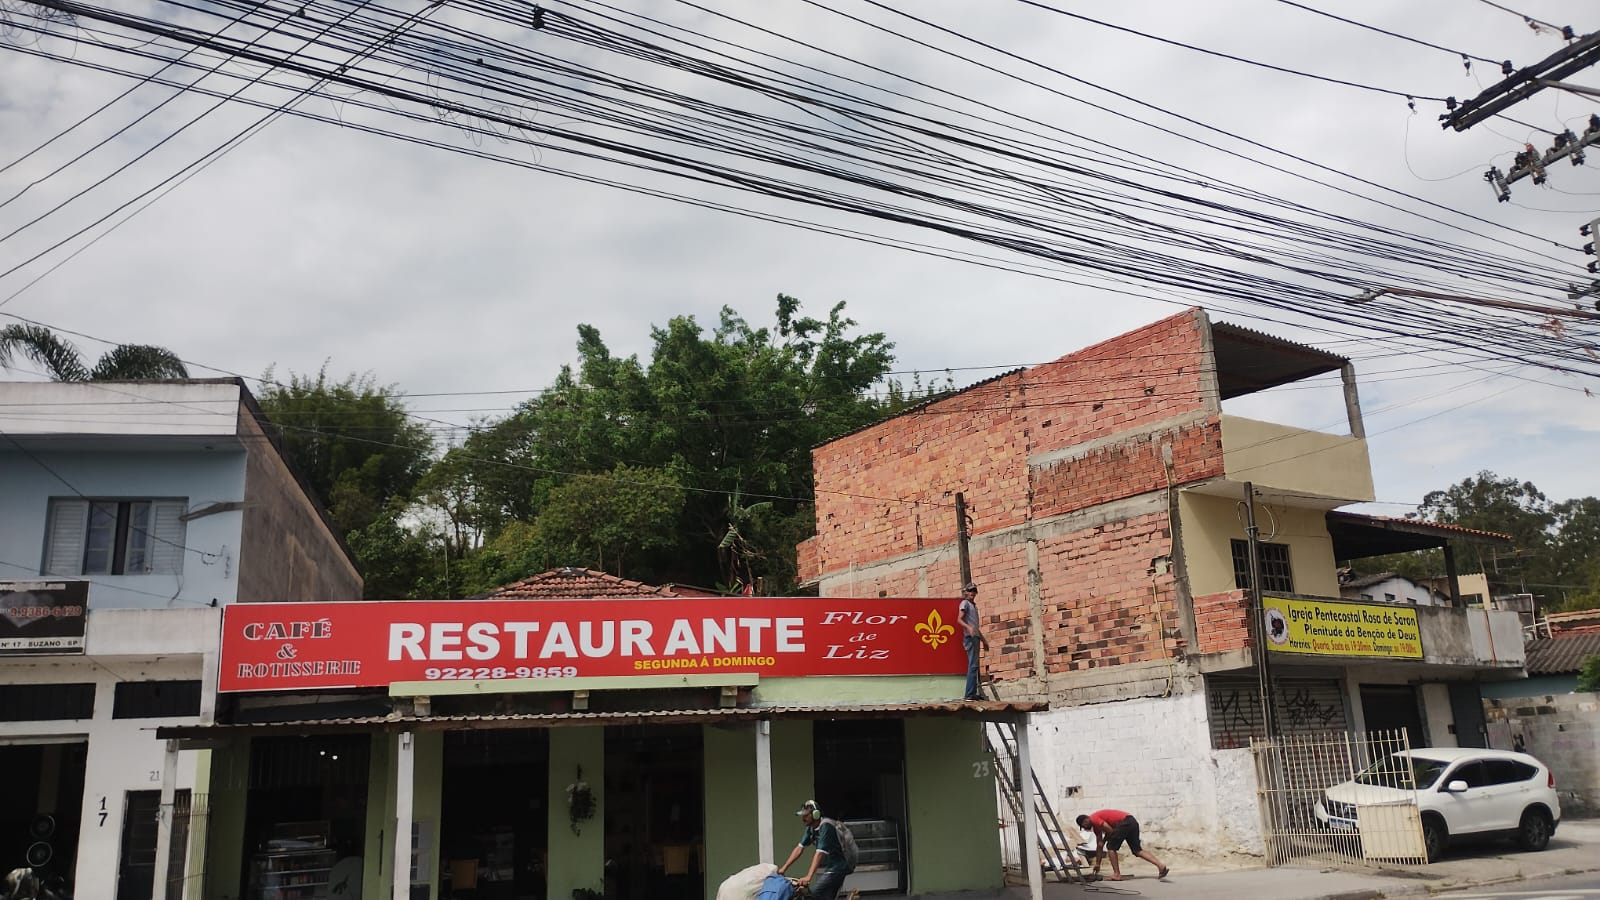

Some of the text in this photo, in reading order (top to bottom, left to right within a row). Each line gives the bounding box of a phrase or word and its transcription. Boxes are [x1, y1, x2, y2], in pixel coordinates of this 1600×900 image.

[819, 611, 909, 626] Flor
[1287, 604, 1313, 623] Igreja
[1314, 607, 1361, 623] Pentecostal
[1362, 610, 1381, 624] Rosa
[1383, 611, 1393, 625] de
[243, 618, 332, 640] CAFÉ
[1304, 624, 1343, 637] Plenitude
[1357, 626, 1385, 641] Benção
[1387, 629, 1396, 640] de
[1397, 628, 1417, 641] Deus
[388, 617, 806, 661] RESTAURANTE
[848, 632, 877, 643] de
[277, 643, 297, 659] &
[822, 644, 890, 660] Liz
[237, 660, 361, 679] ROTISSERIE
[634, 658, 698, 670] SEGUNDA
[713, 657, 776, 668] DOMINGO
[425, 666, 577, 680] 92228-9859
[149, 770, 160, 781] 21
[972, 760, 990, 778] 23
